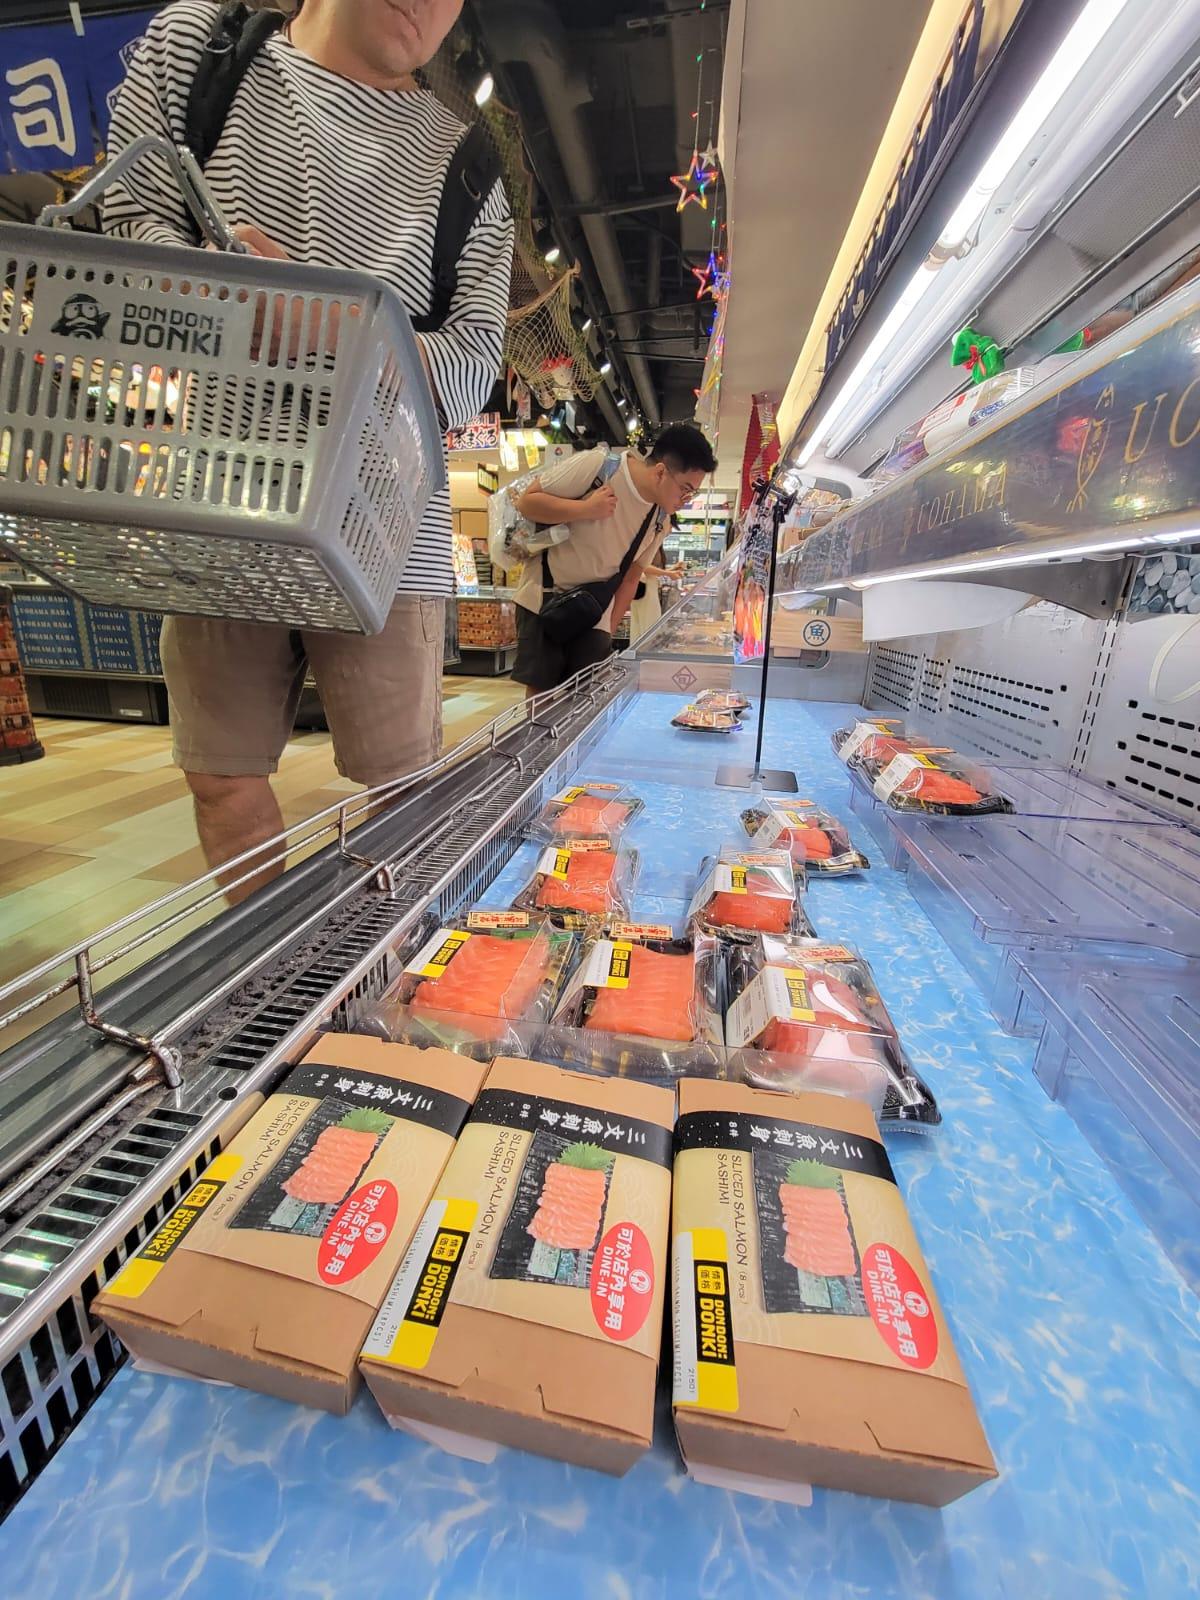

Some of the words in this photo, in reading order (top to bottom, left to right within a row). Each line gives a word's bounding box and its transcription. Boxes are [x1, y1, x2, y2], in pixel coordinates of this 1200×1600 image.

[6, 57, 76, 157] 司
[120, 320, 222, 357] DONKI
[808, 623, 826, 642] 魚
[334, 1076, 433, 1111] 三文魚刺身
[257, 1099, 299, 1144] SASHIMI
[277, 1099, 311, 1137] SLICED
[539, 1107, 647, 1145] 三文魚刺身
[749, 1123, 864, 1160] 三文魚刺身
[233, 1135, 282, 1191] SALMON
[484, 1131, 510, 1181] SASHIMI
[502, 1133, 523, 1175] SLICED
[731, 1154, 745, 1202] SLICED
[716, 1152, 730, 1206] SASHIMI
[326, 1199, 360, 1247] DINE-IN
[480, 1176, 508, 1236] SALMON
[144, 1208, 188, 1255] DONKI
[733, 1204, 748, 1266] SALMON
[411, 1262, 441, 1319] DONKI
[595, 1245, 614, 1298] DINE-IN
[866, 1270, 890, 1325] DINE-IN
[700, 1297, 717, 1358] DONKI
